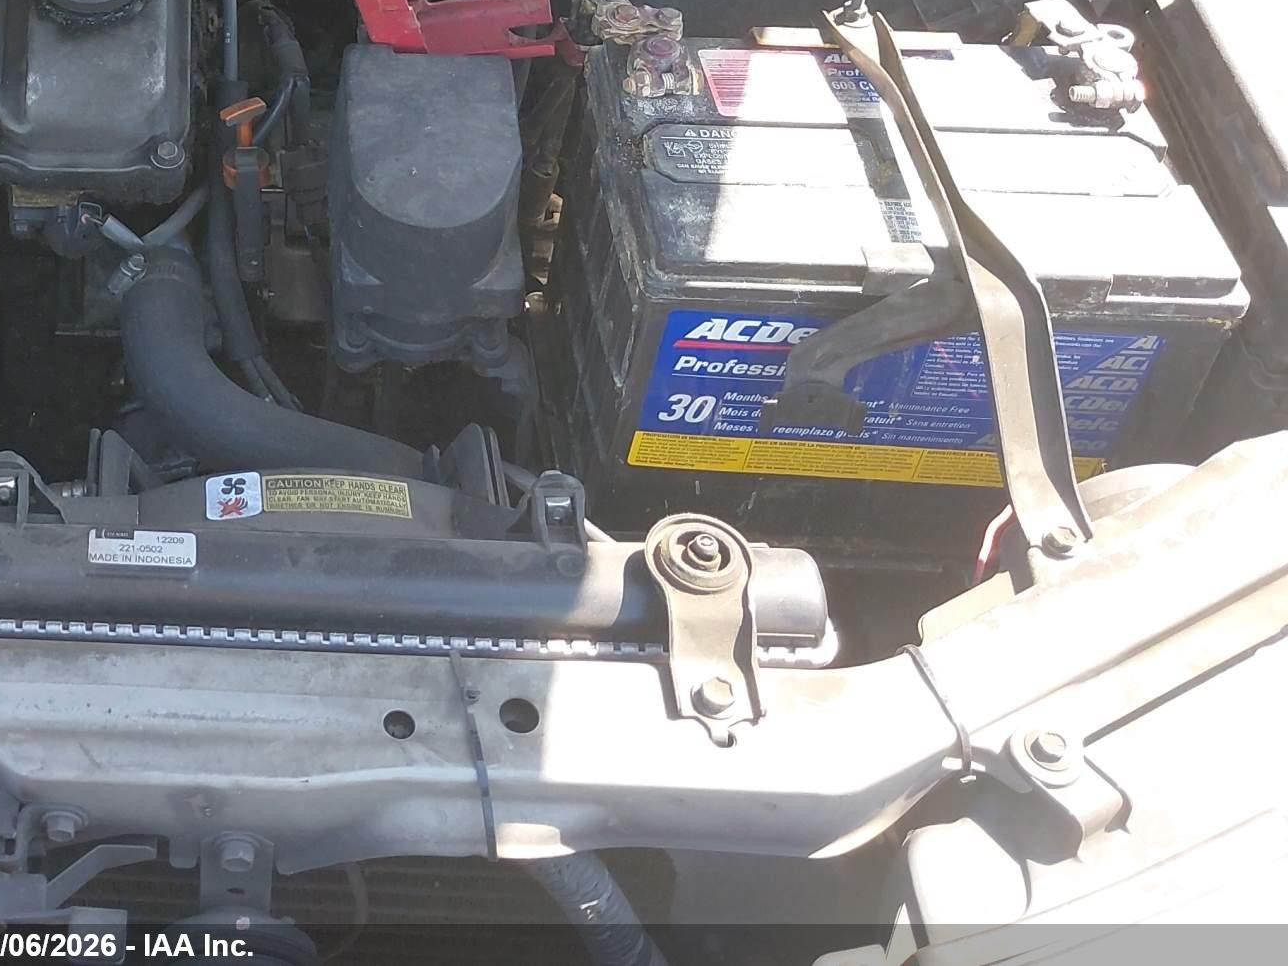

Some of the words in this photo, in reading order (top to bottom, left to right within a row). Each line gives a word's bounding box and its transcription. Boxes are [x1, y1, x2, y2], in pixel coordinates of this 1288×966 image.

[831, 81, 856, 90] 600
[1128, 335, 1159, 350] A
[1096, 355, 1150, 371] AC
[658, 394, 717, 423] 30
[718, 407, 748, 418] Mois
[888, 401, 948, 413] Maintenance
[949, 405, 970, 414] Free
[714, 421, 754, 432] Meses
[905, 418, 928, 427] Sans
[929, 420, 971, 429] entretien
[772, 425, 834, 439] reemplazo
[881, 432, 898, 441] Sin
[268, 479, 322, 489] CAUTION
[323, 479, 345, 490] KEEP
[348, 481, 376, 491] HANDS
[156, 535, 185, 544] 12209
[119, 544, 163, 554] 221-0502
[90, 553, 119, 562] MADE
[122, 554, 132, 562] IN
[134, 554, 193, 565] INDONESIA
